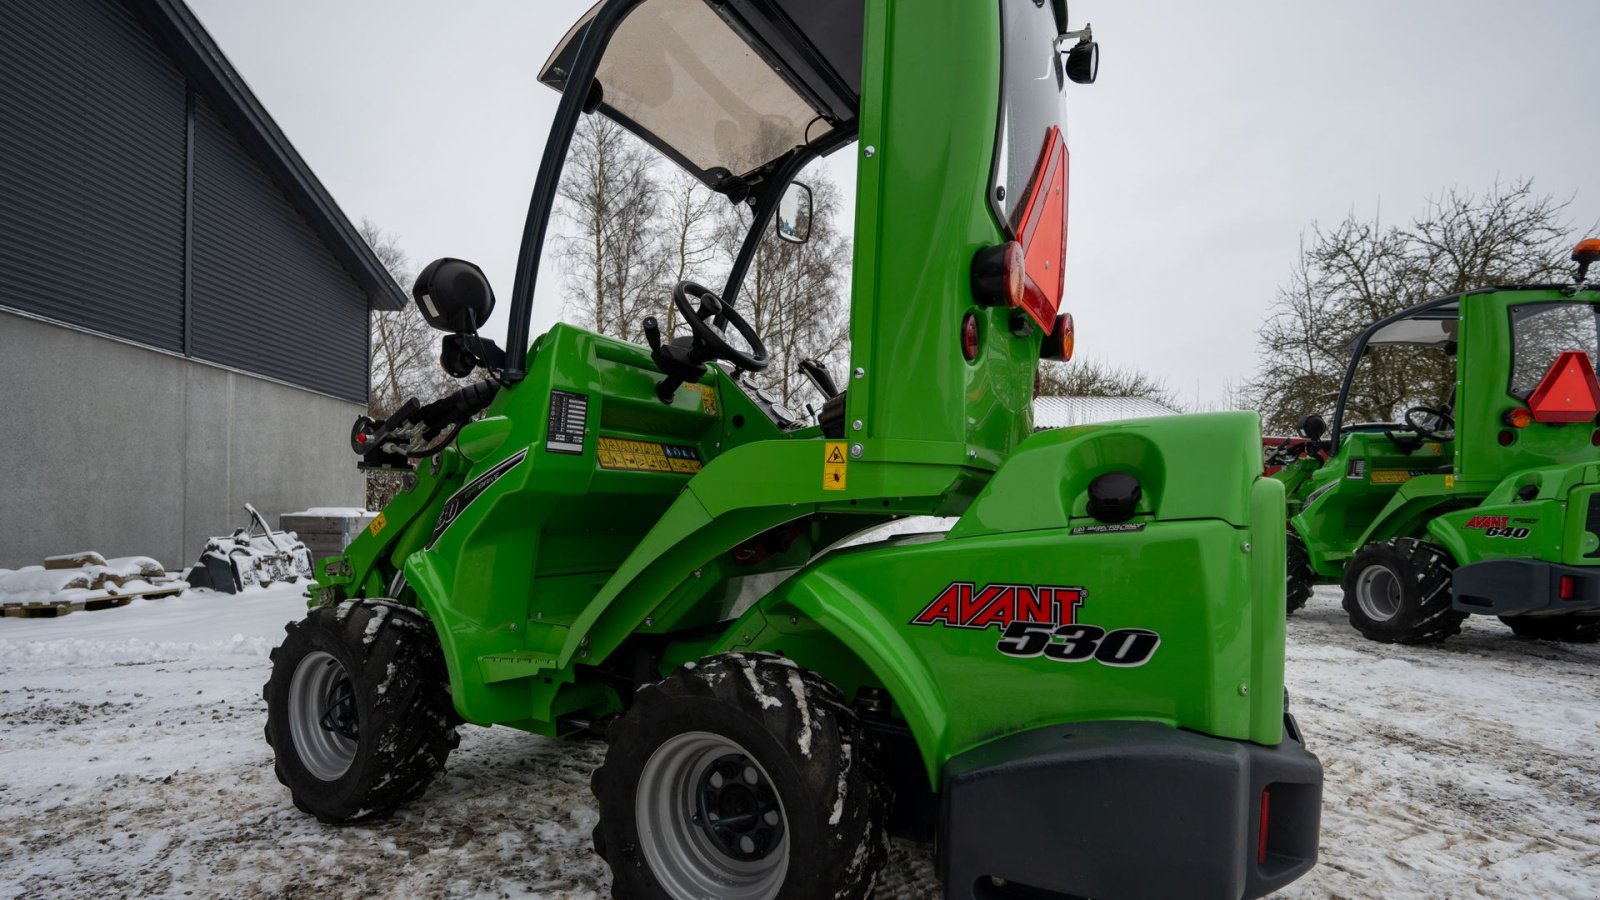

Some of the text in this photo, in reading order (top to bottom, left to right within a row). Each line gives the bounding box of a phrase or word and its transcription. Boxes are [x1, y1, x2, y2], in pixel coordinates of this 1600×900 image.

[1464, 515, 1509, 529] AVANT
[1485, 527, 1530, 539] 640
[996, 620, 1161, 668] 530
